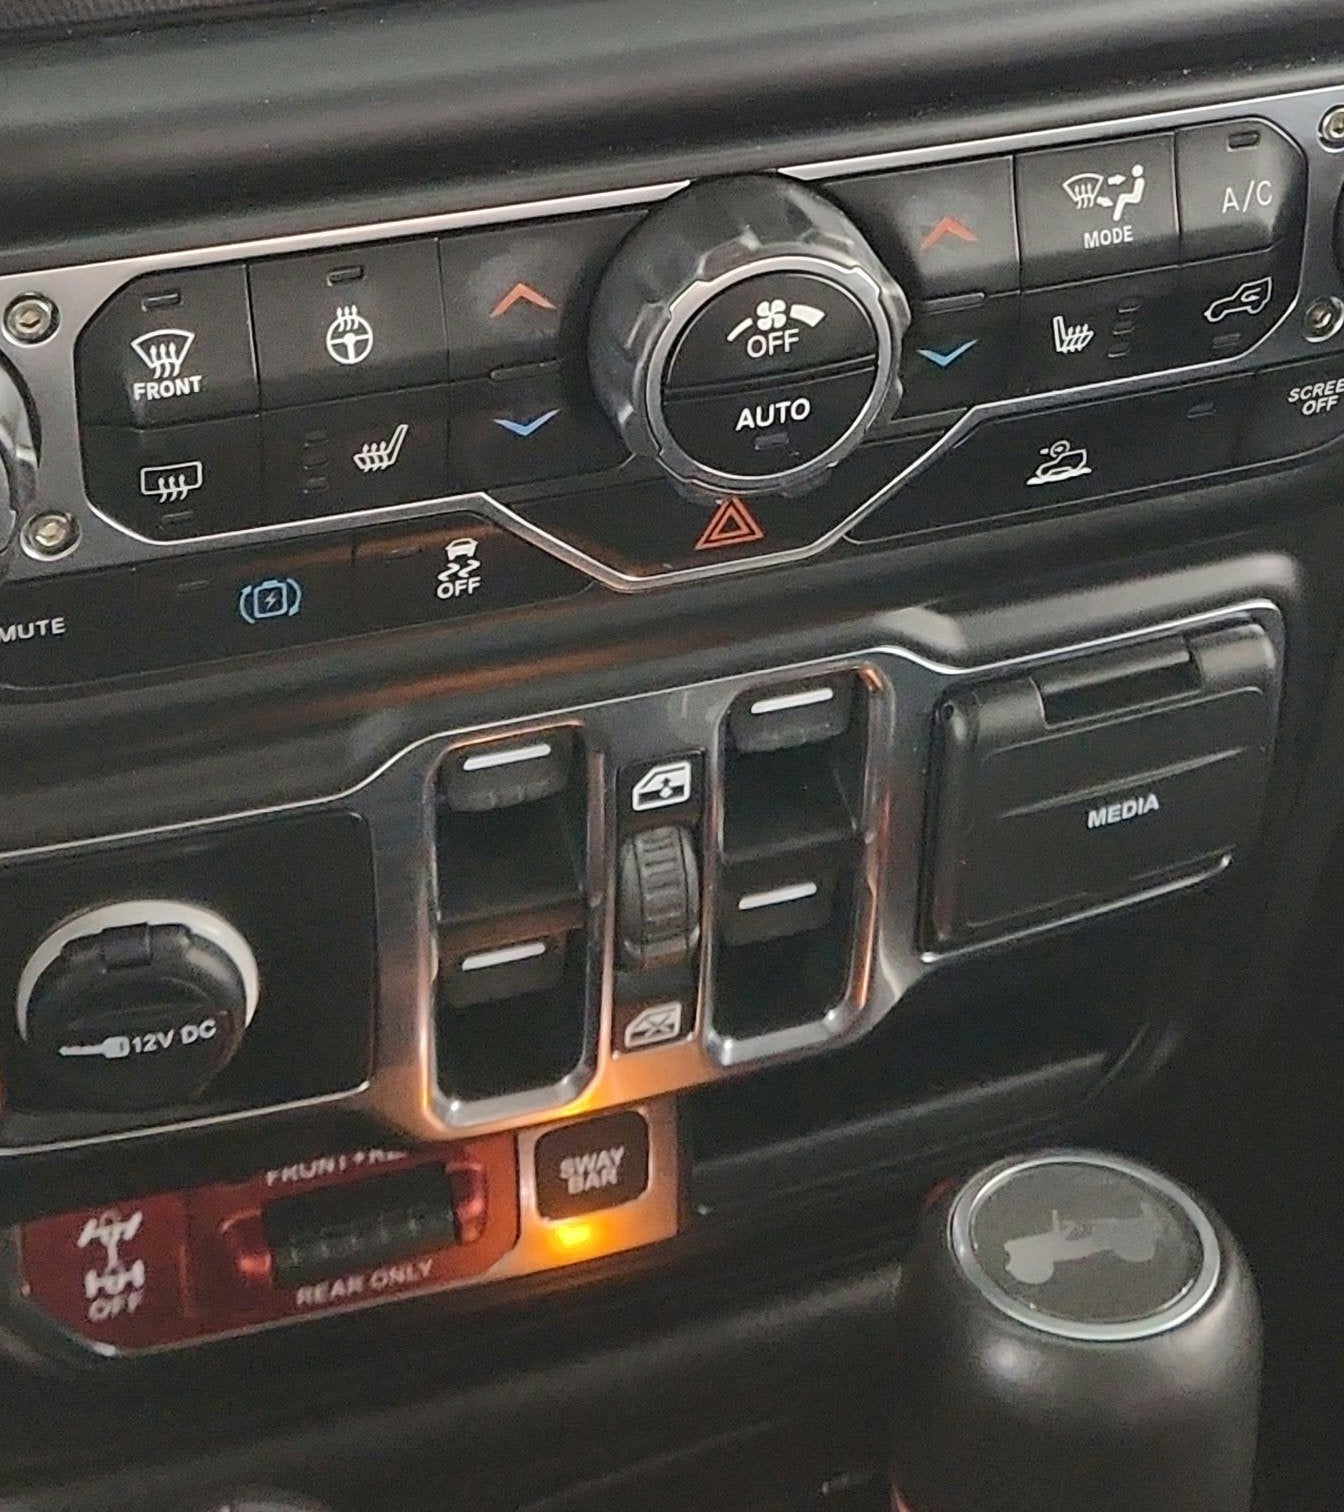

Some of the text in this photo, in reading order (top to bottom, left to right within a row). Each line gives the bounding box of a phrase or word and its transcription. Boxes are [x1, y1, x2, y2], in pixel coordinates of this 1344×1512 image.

[1221, 180, 1272, 213] A/C
[1084, 225, 1133, 249] MODE
[747, 329, 799, 358] OFF
[133, 375, 202, 401] FRONT
[735, 398, 810, 430] AUTO
[1302, 395, 1339, 415] OFF
[436, 578, 481, 599] OFF
[1087, 793, 1159, 829] MEDIA
[131, 1019, 217, 1055] 12V DC
[559, 1146, 624, 1178] SWAY
[567, 1167, 618, 1194] BAR
[296, 1259, 434, 1307] REAR ONLY
[87, 1293, 143, 1322] OFF
